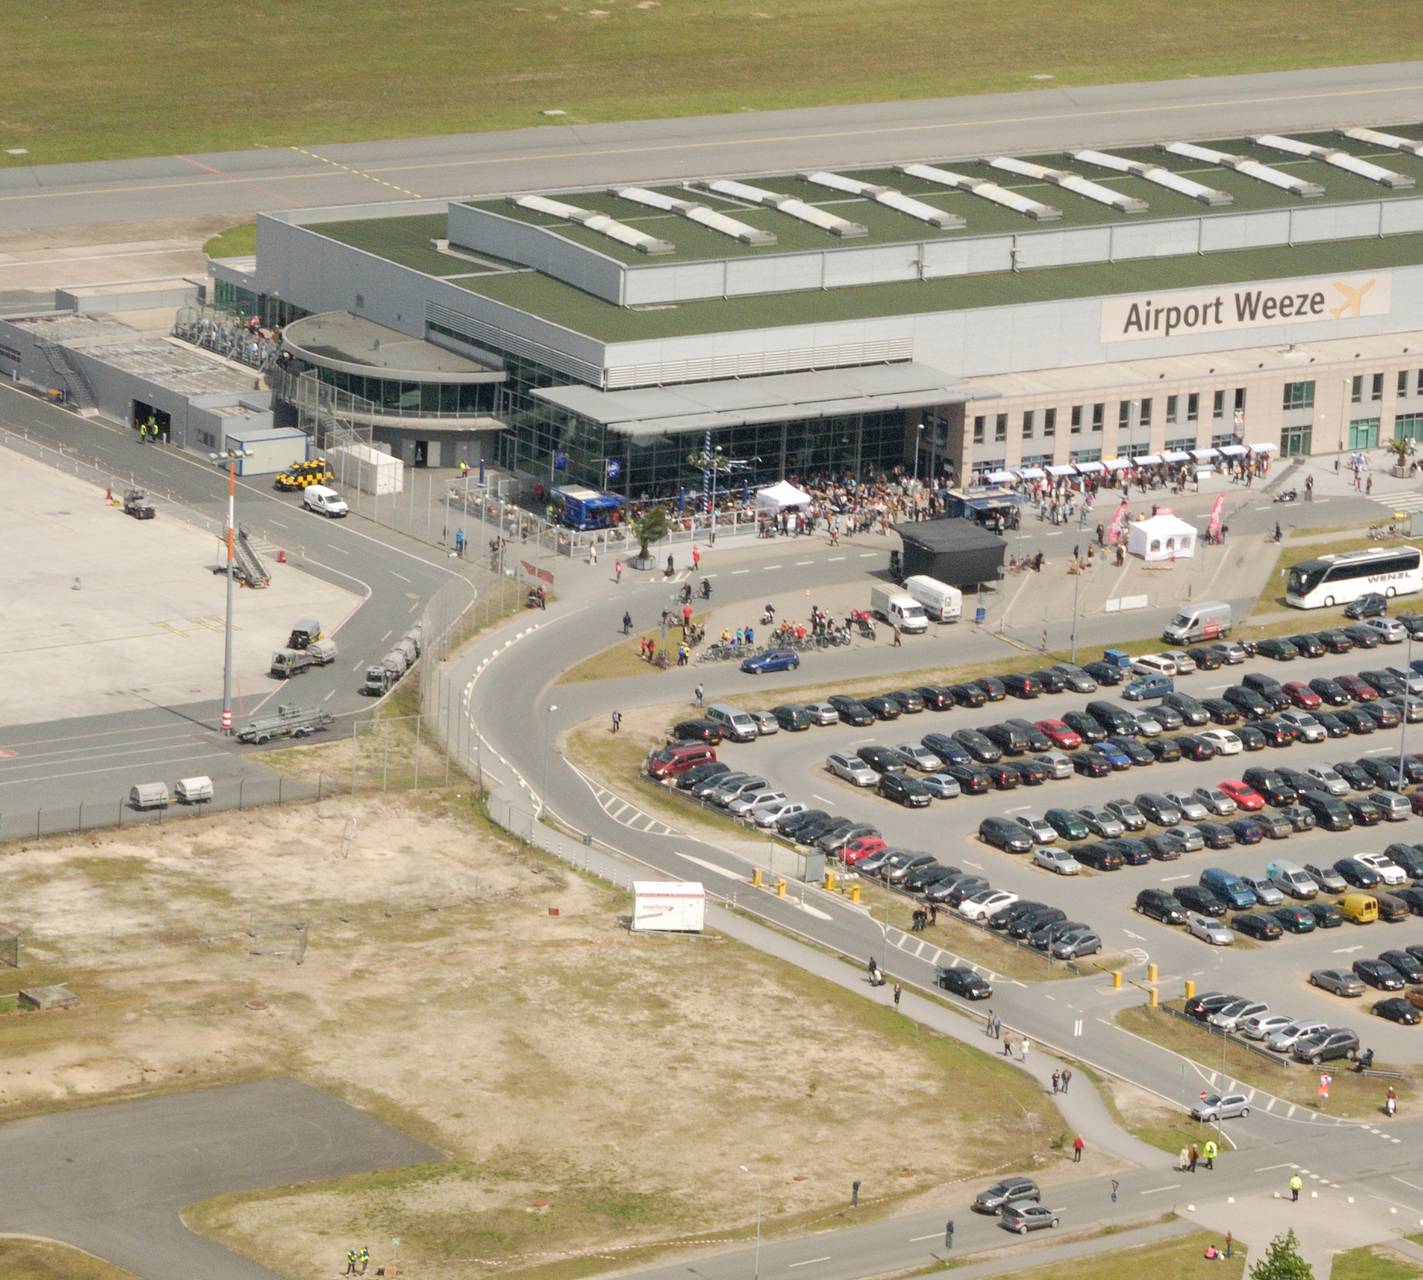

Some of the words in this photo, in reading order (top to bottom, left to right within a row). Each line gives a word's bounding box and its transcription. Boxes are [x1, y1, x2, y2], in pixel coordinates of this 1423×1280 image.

[1123, 296, 1223, 336] Airport
[1234, 290, 1325, 322] Weeze
[1368, 572, 1411, 583] WENZL
